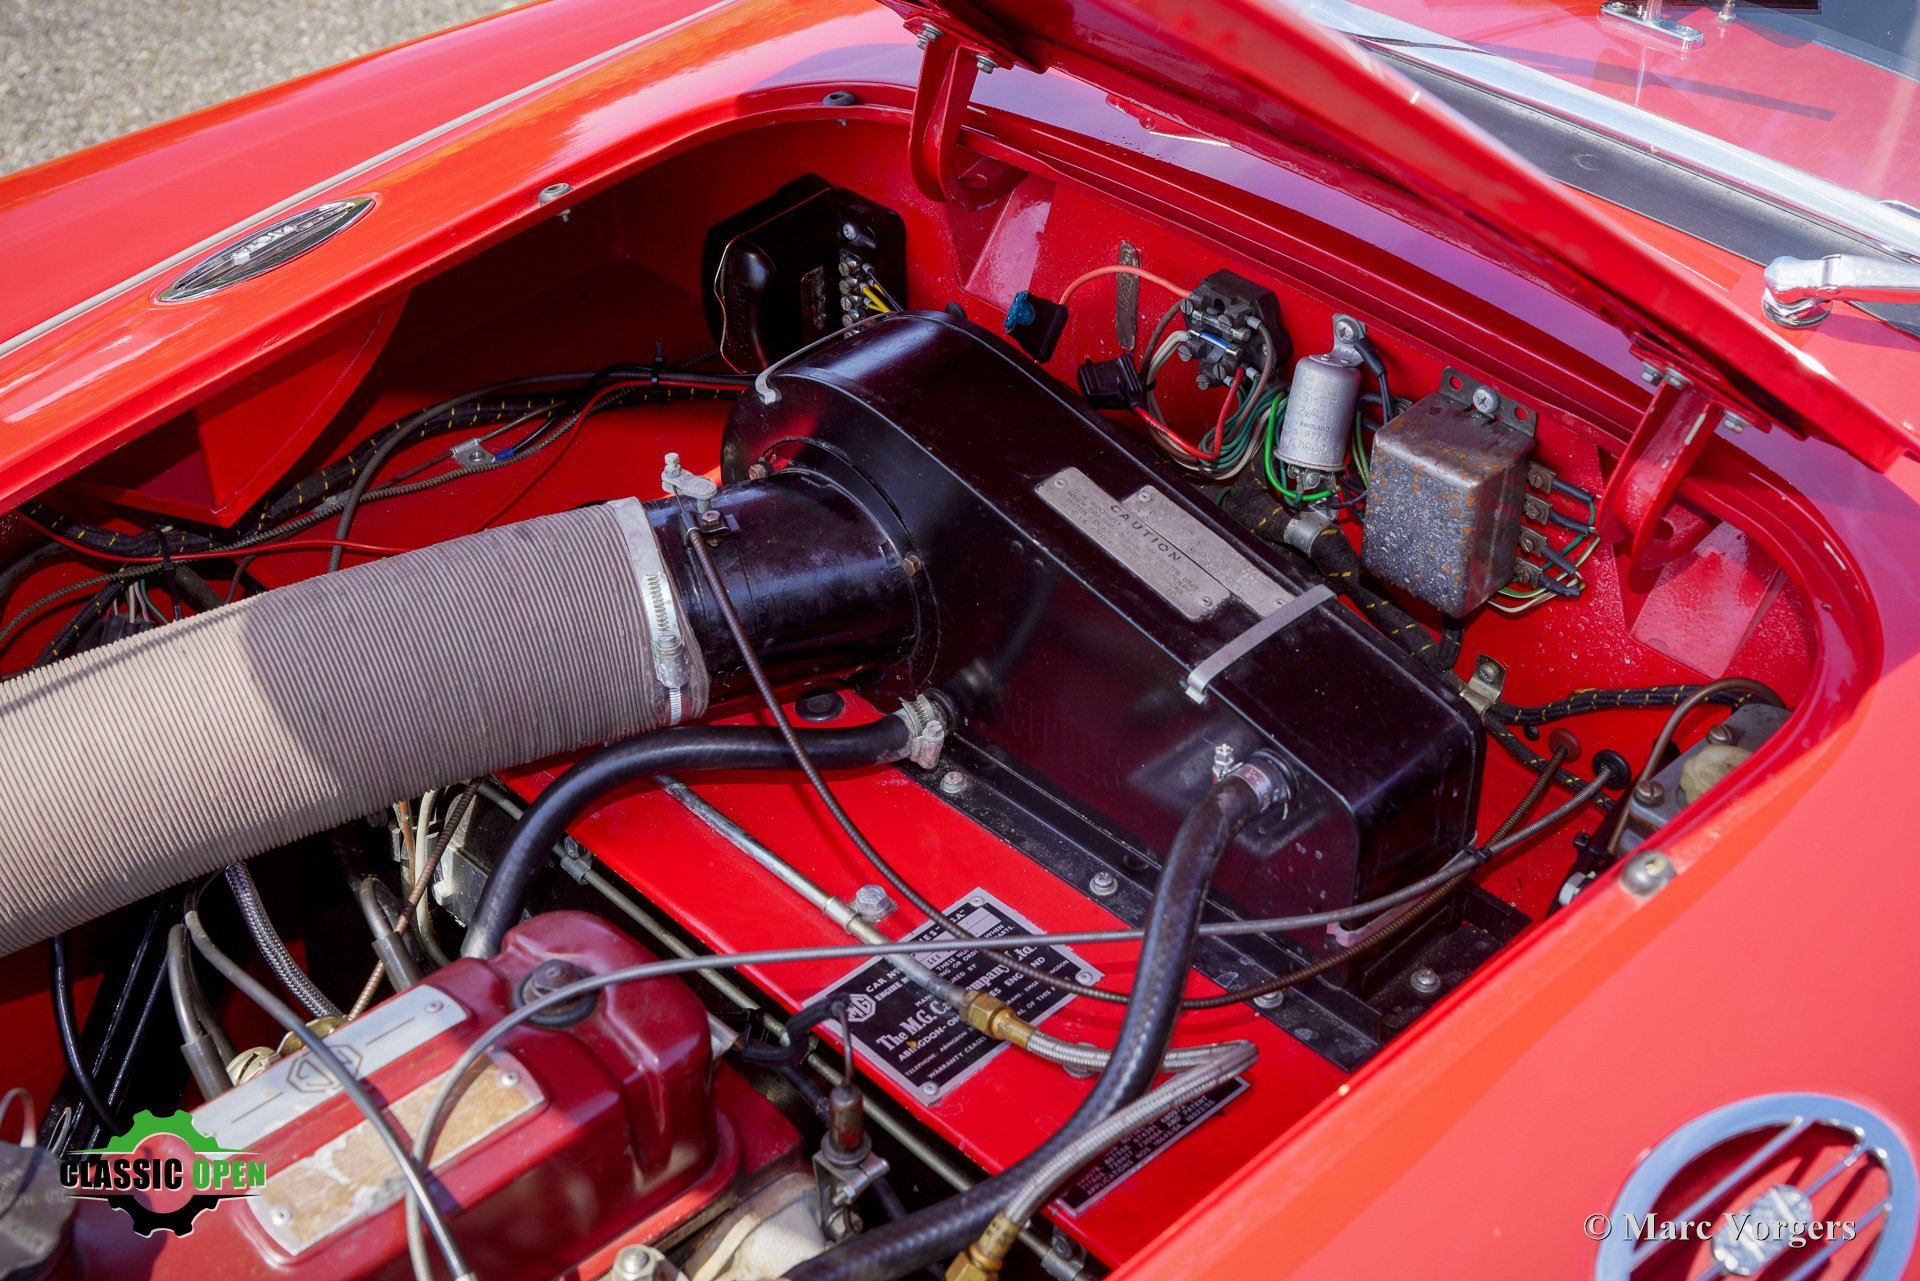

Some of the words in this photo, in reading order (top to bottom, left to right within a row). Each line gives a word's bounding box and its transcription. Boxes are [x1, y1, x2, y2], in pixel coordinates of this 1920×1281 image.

[1108, 503, 1182, 562] CAUTION
[925, 952, 942, 965] SEE
[934, 956, 957, 972] THESE
[983, 922, 1005, 939] WHEN
[950, 959, 963, 969] OR
[993, 923, 1016, 940] ARTS.
[863, 976, 887, 994] CAR
[965, 962, 978, 971] BY
[1002, 954, 1047, 987] ENGND
[872, 979, 903, 1002] ENGINE
[874, 1025, 910, 1052] The
[898, 1005, 939, 1036] M.G.
[926, 996, 953, 1015] Ca
[926, 1050, 965, 1079] WARRANTY
[962, 1034, 988, 1053] CEASES
[1024, 1000, 1036, 1009] OF
[1034, 989, 1052, 1002] THIS
[1086, 1158, 1132, 1196] APPLICATIONS
